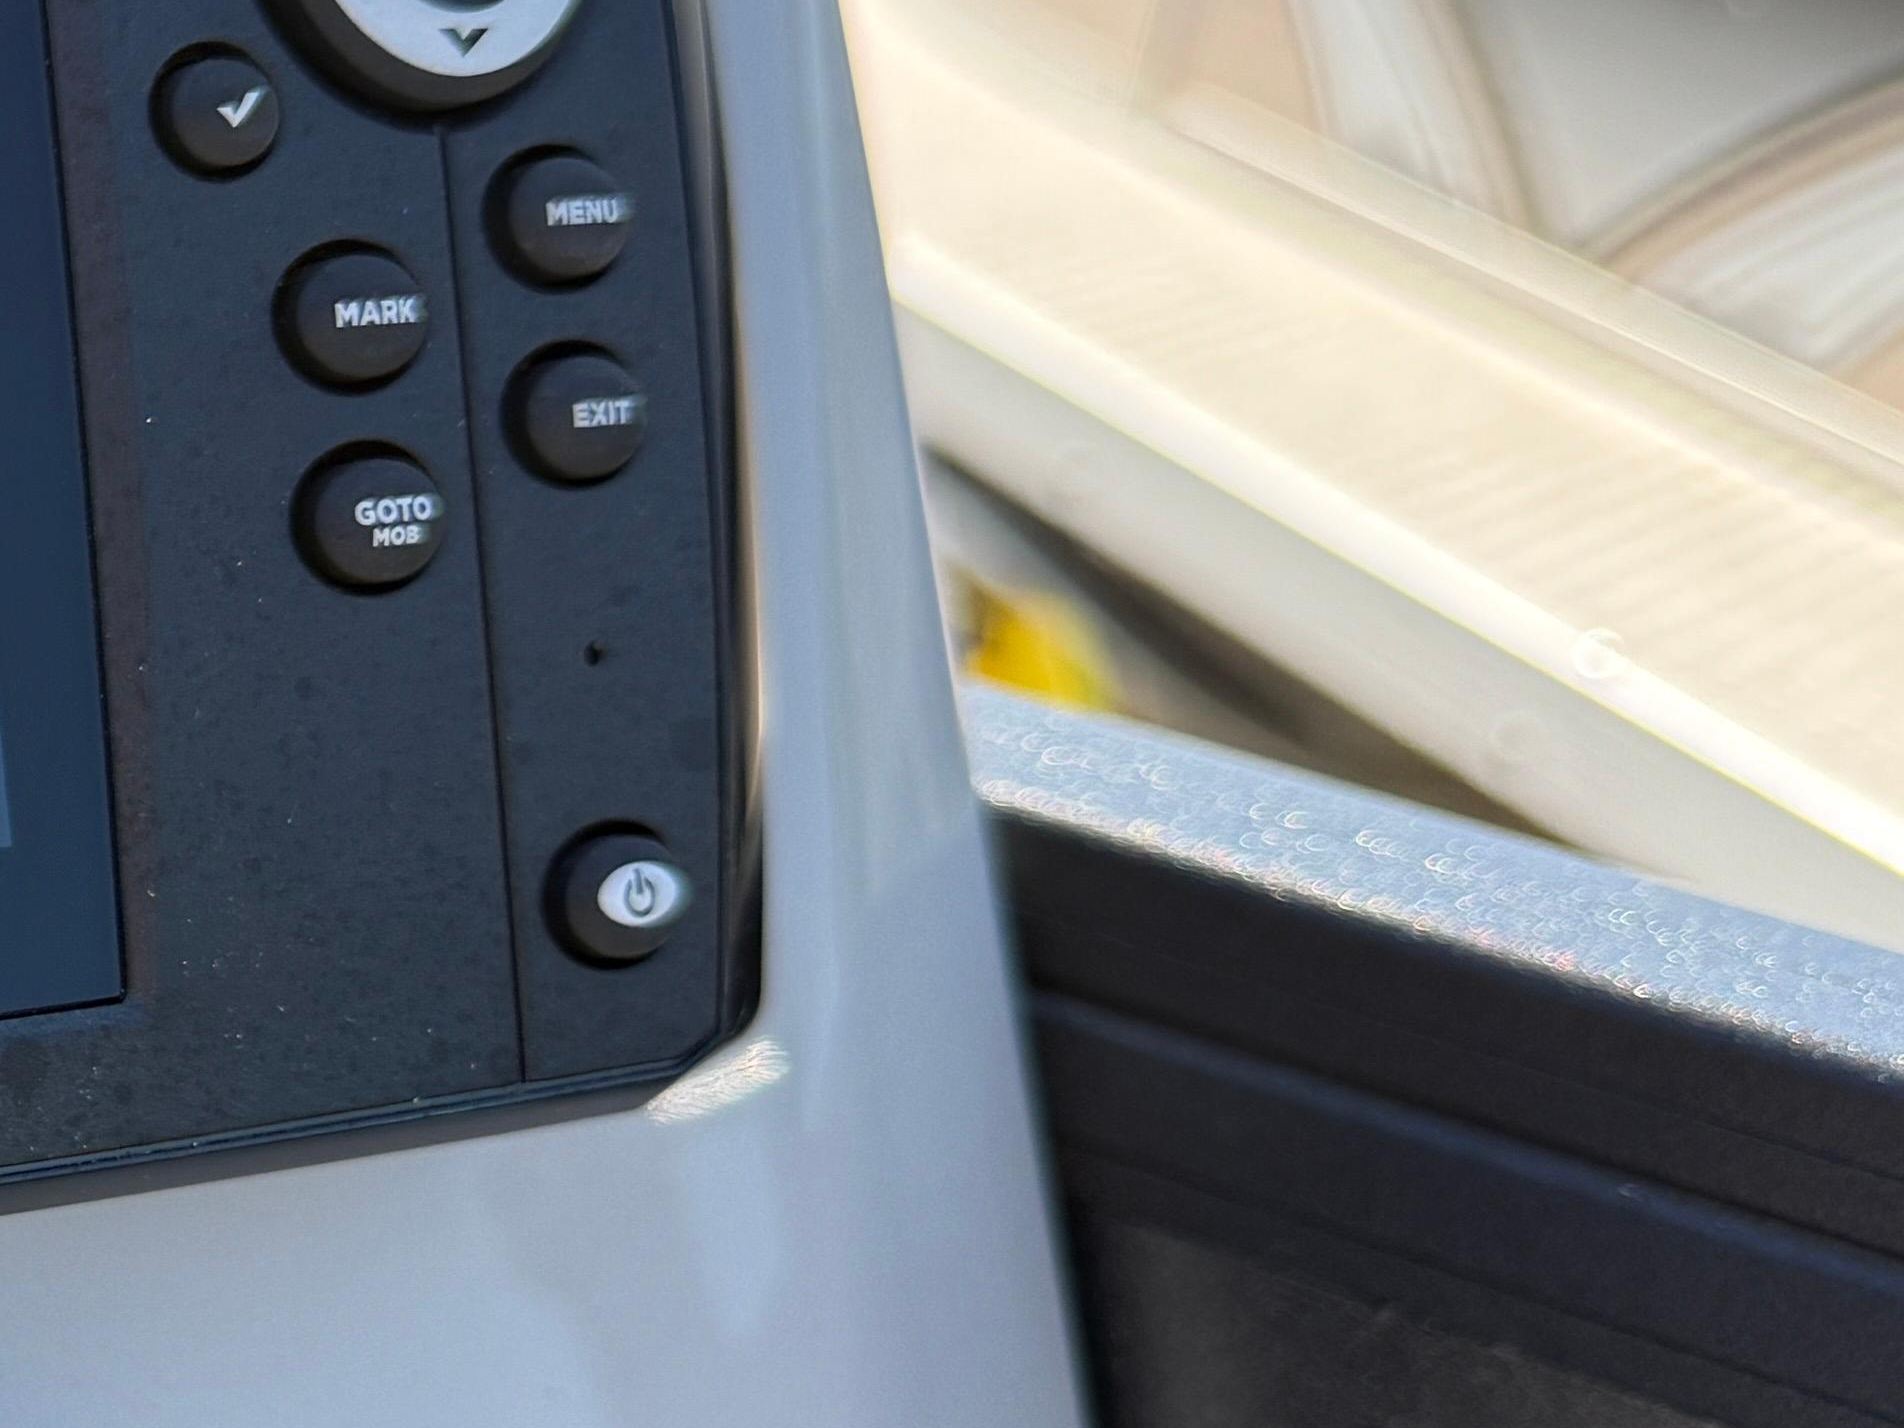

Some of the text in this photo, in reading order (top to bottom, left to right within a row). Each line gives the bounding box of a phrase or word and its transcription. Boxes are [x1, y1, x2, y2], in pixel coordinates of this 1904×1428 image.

[545, 196, 622, 227] MENU
[333, 295, 420, 329] MARK
[571, 396, 634, 429] EXIT
[353, 494, 435, 526] GOTO
[371, 523, 422, 548] MOB
